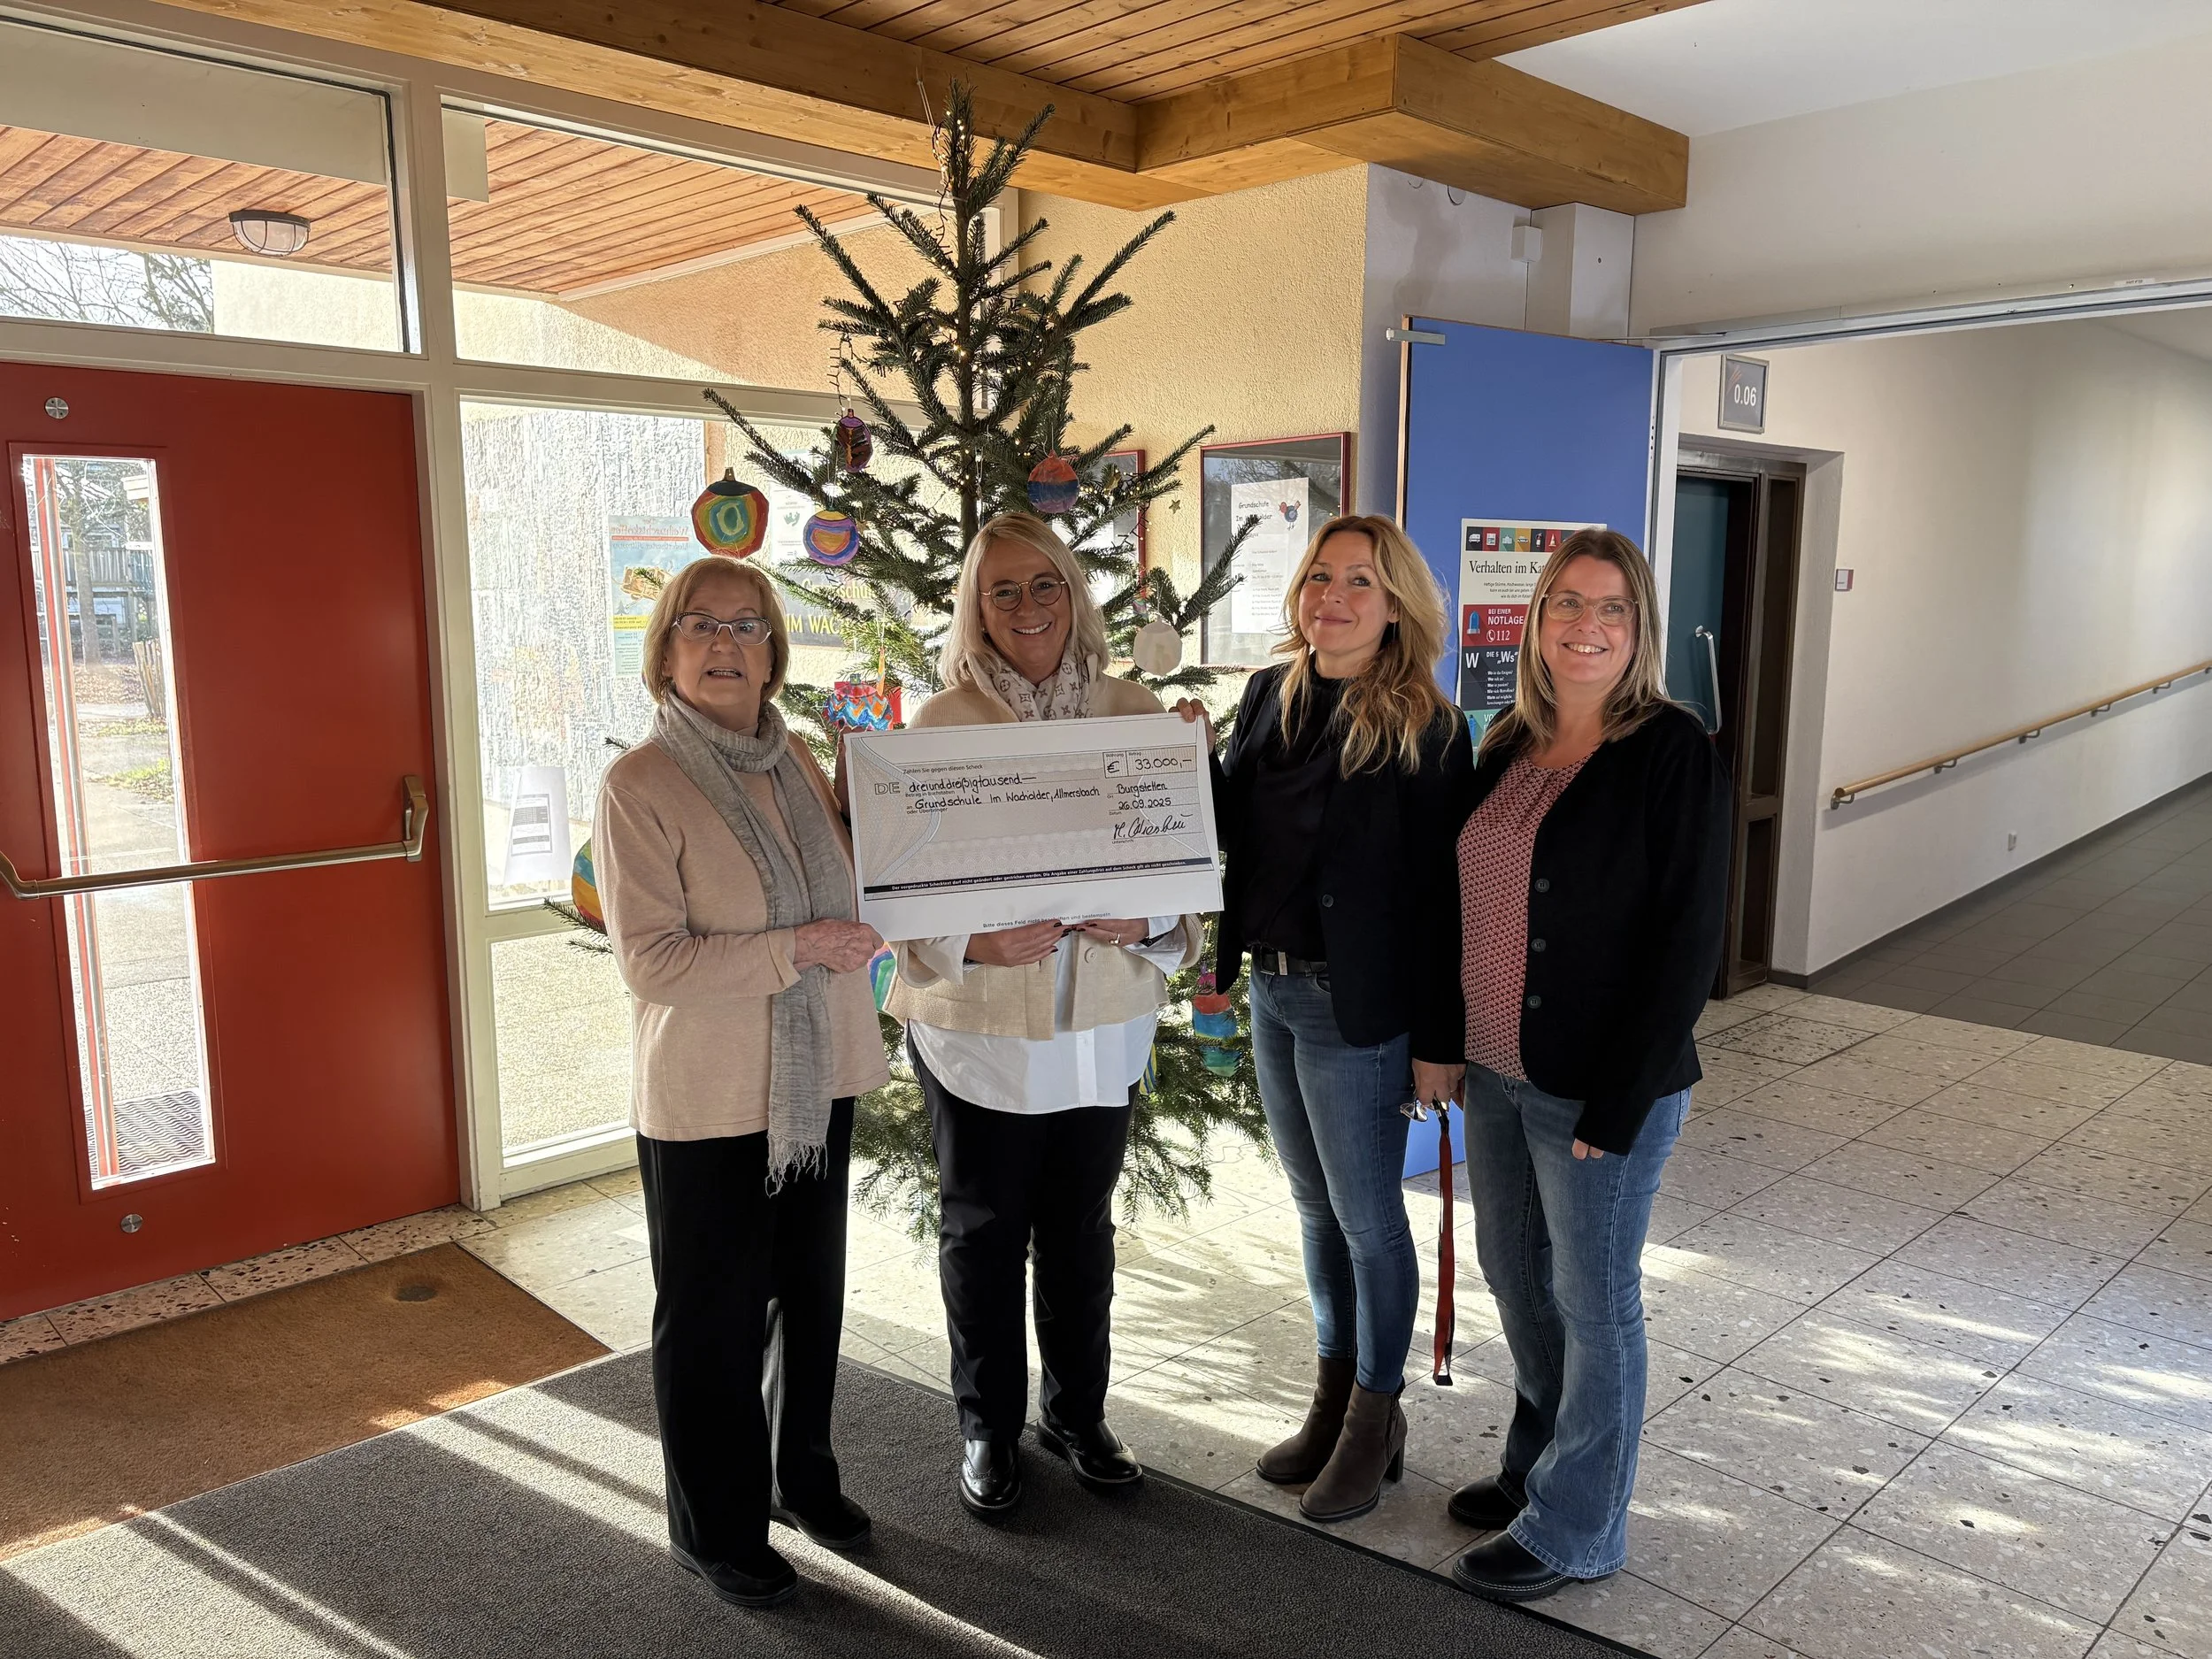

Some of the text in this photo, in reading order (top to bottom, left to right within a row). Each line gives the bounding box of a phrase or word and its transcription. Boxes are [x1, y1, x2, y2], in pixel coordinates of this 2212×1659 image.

[1734, 384, 1756, 406] 0.06
[1469, 560, 1511, 573] Verhalten
[1515, 561, 1527, 573] im
[1488, 616, 1524, 625] NOTLAGE
[1497, 630, 1510, 641] 112
[1465, 652, 1479, 668] W
[1107, 761, 1119, 773] €
[874, 782, 901, 795] DE
[1116, 781, 1168, 798] Burgstetten
[915, 795, 982, 810] Grundschule
[990, 794, 1001, 803] Im
[1118, 797, 1171, 810] 26.09.2025
